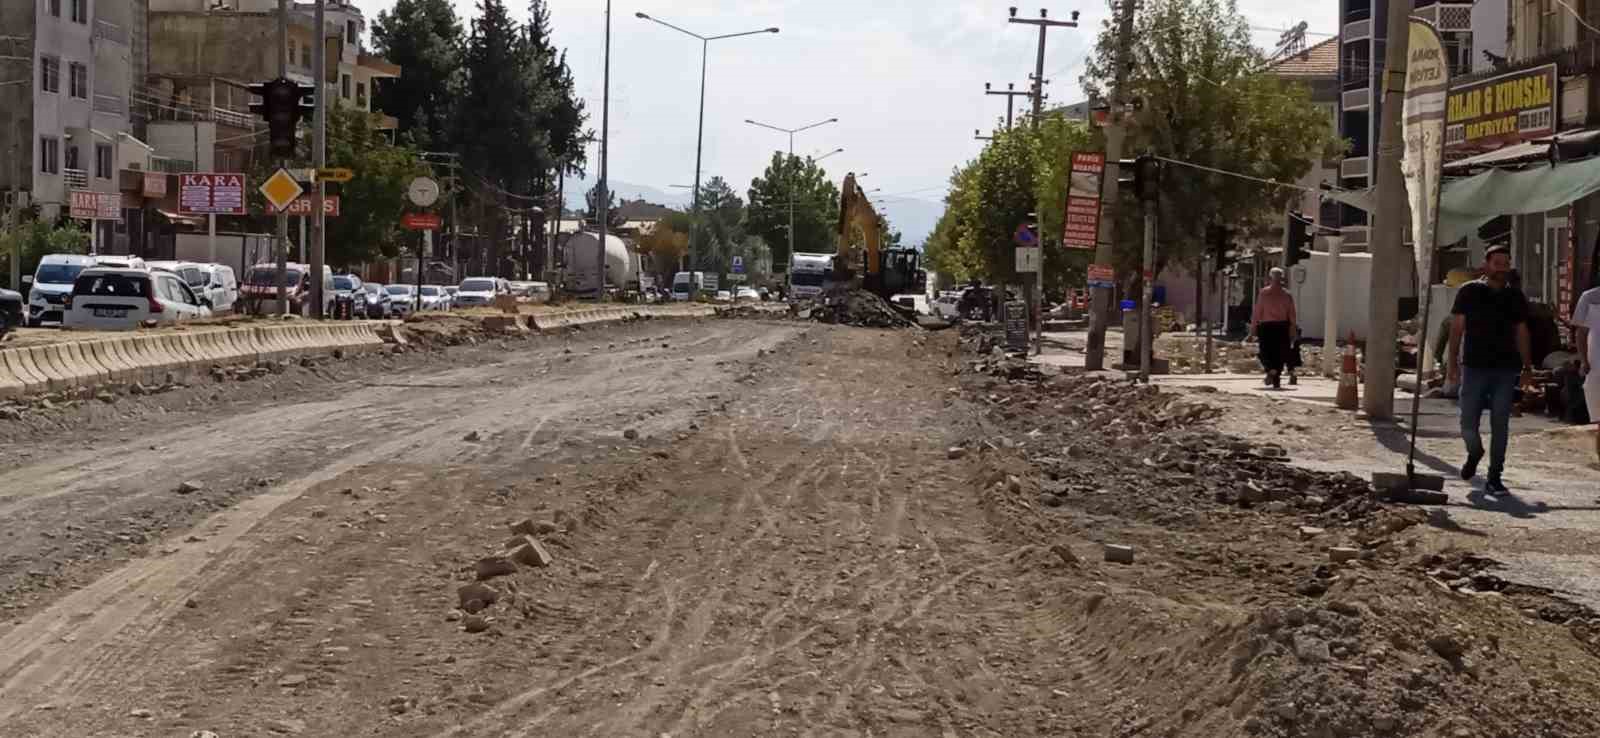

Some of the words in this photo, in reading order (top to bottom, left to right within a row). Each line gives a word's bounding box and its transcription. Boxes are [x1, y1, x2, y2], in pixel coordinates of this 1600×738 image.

[1495, 74, 1552, 113] KUMSAL
[185, 175, 241, 186] KARA
[73, 192, 96, 209] KARA
